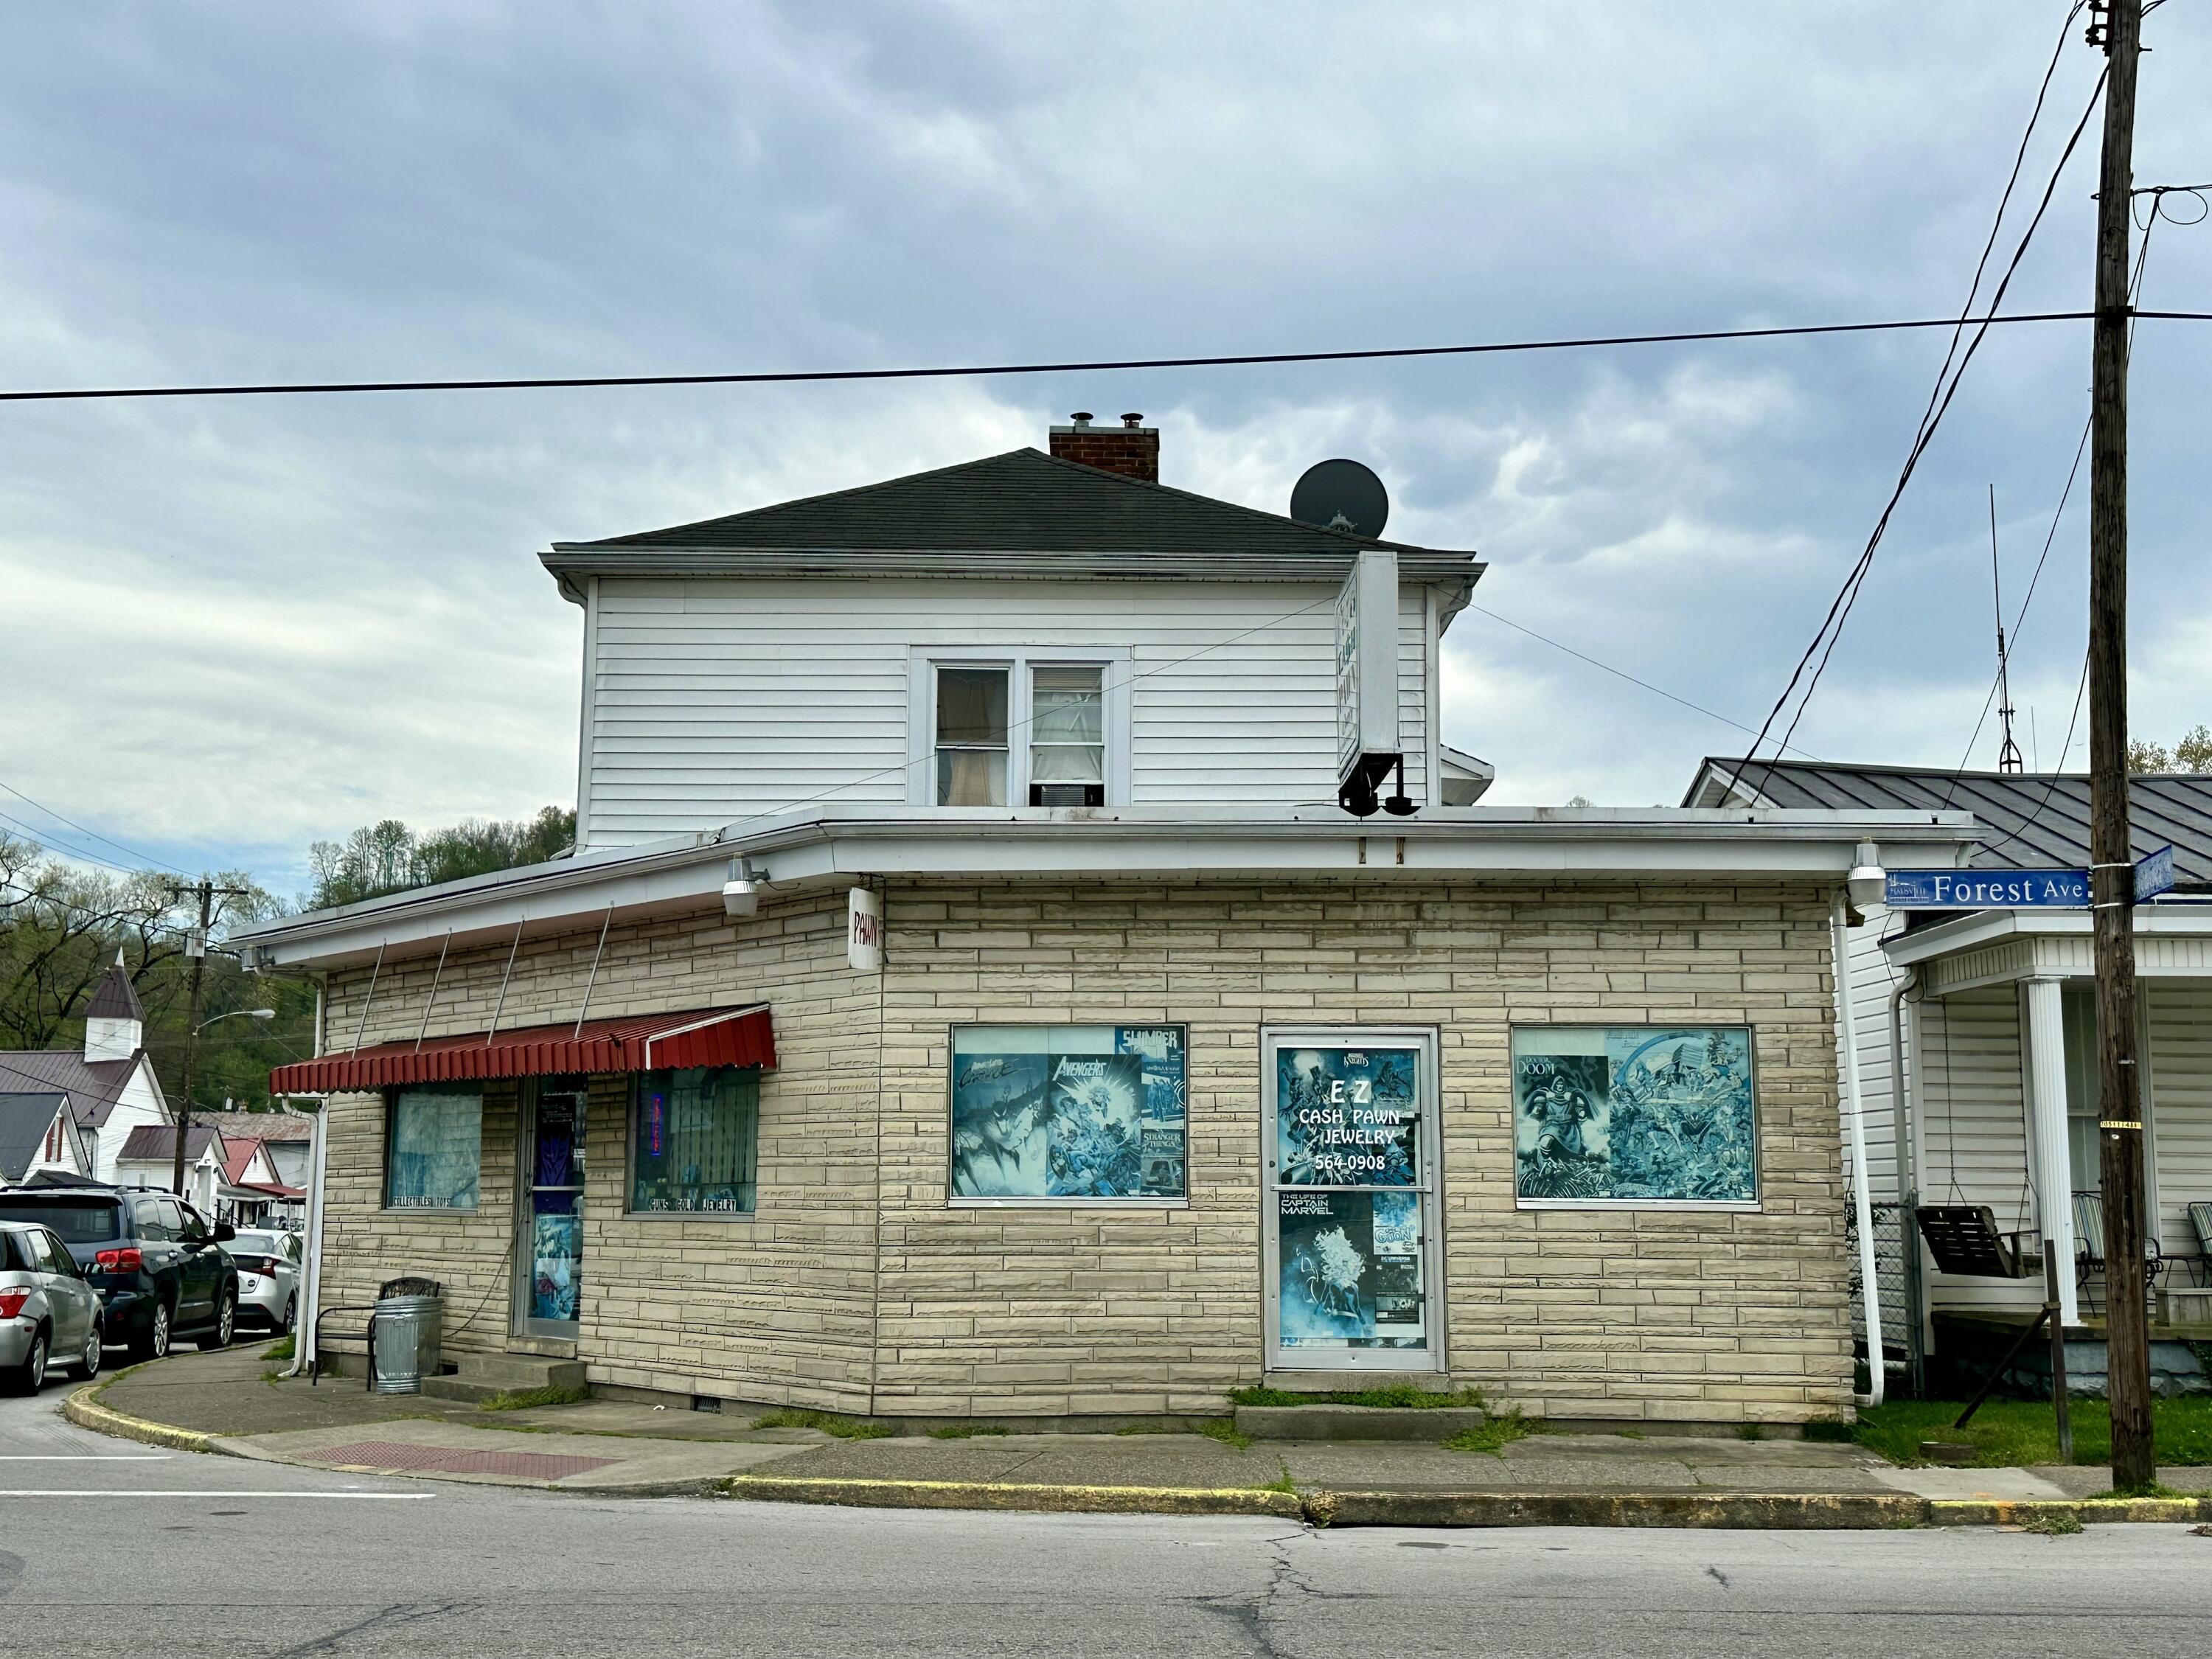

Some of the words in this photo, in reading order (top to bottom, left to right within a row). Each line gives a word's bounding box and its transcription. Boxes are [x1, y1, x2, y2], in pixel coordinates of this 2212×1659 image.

[1933, 876, 2034, 902] Forest
[2043, 880, 2083, 897] Ave
[854, 911, 877, 947] PAWN
[1052, 1055, 1107, 1082] AVENGERS
[1516, 1060, 1555, 1074] DOOM
[1299, 1109, 1344, 1124] CASH
[1353, 1109, 1399, 1124] PAWN
[1324, 1130, 1396, 1144] JEWELRY
[1315, 1155, 1385, 1170] 564-0908
[437, 1197, 452, 1207] TOYS
[650, 1198, 669, 1211] GUNS
[676, 1198, 695, 1211] GOLD
[703, 1198, 737, 1211] JEWELRY
[1281, 1206, 1334, 1215] MARVEL
